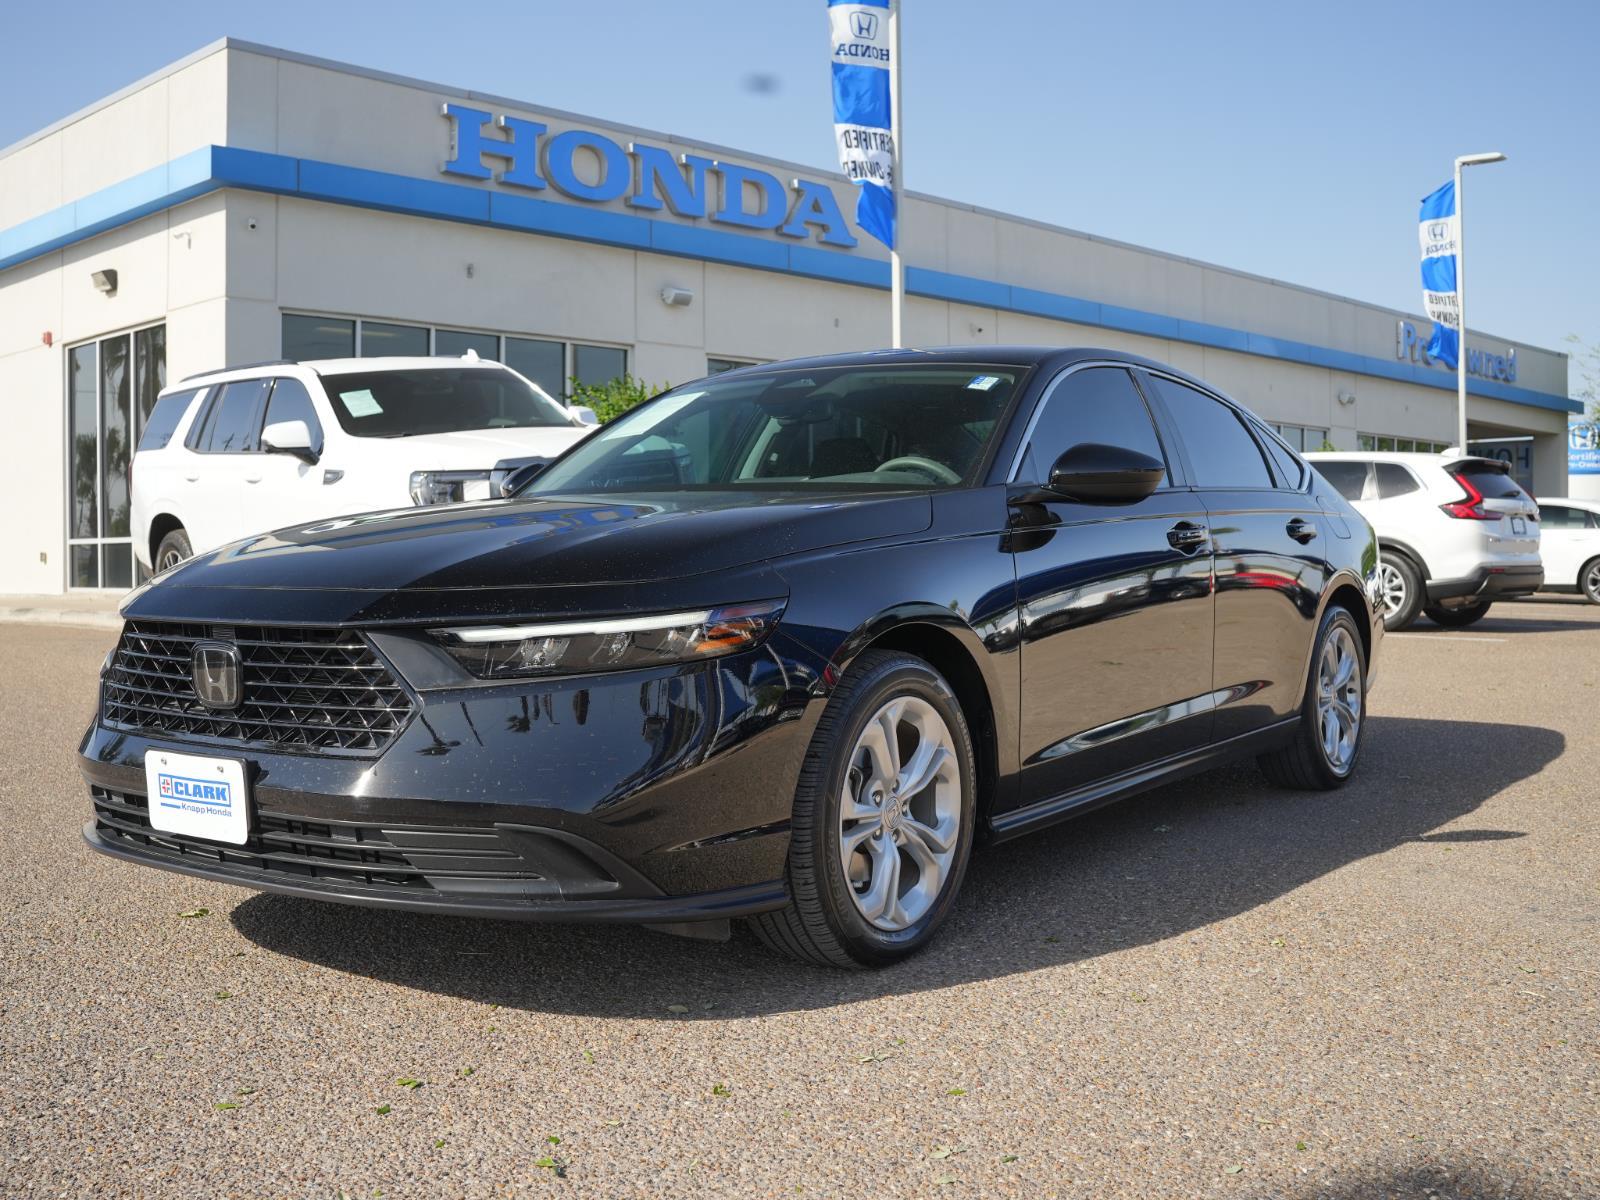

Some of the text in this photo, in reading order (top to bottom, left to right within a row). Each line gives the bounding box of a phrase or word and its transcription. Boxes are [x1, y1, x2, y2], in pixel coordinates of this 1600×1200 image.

[441, 102, 858, 248] HONDA
[174, 781, 228, 802] CLARK
[181, 802, 233, 818] Knapp Honda
